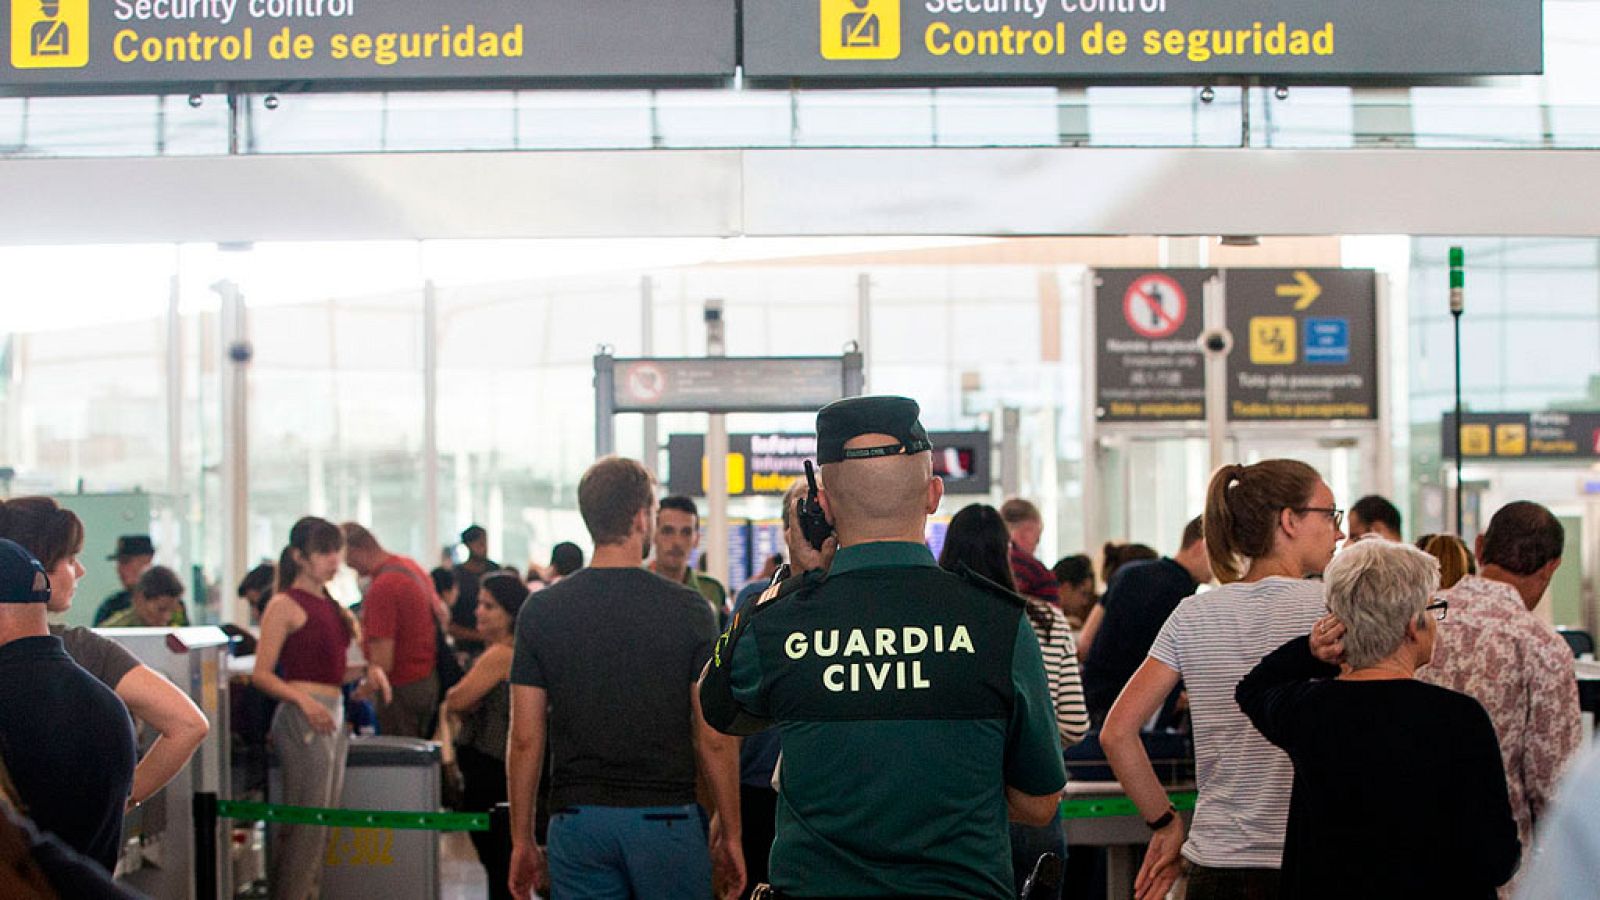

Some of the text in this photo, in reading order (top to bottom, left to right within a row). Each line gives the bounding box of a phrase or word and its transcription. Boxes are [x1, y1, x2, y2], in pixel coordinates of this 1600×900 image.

[114, 0, 354, 24] Security control
[113, 23, 524, 65] Control de seguridad
[924, 22, 1334, 62] Control de seguridad
[785, 625, 976, 659] GUARDIA
[823, 660, 931, 692] CIVIL
